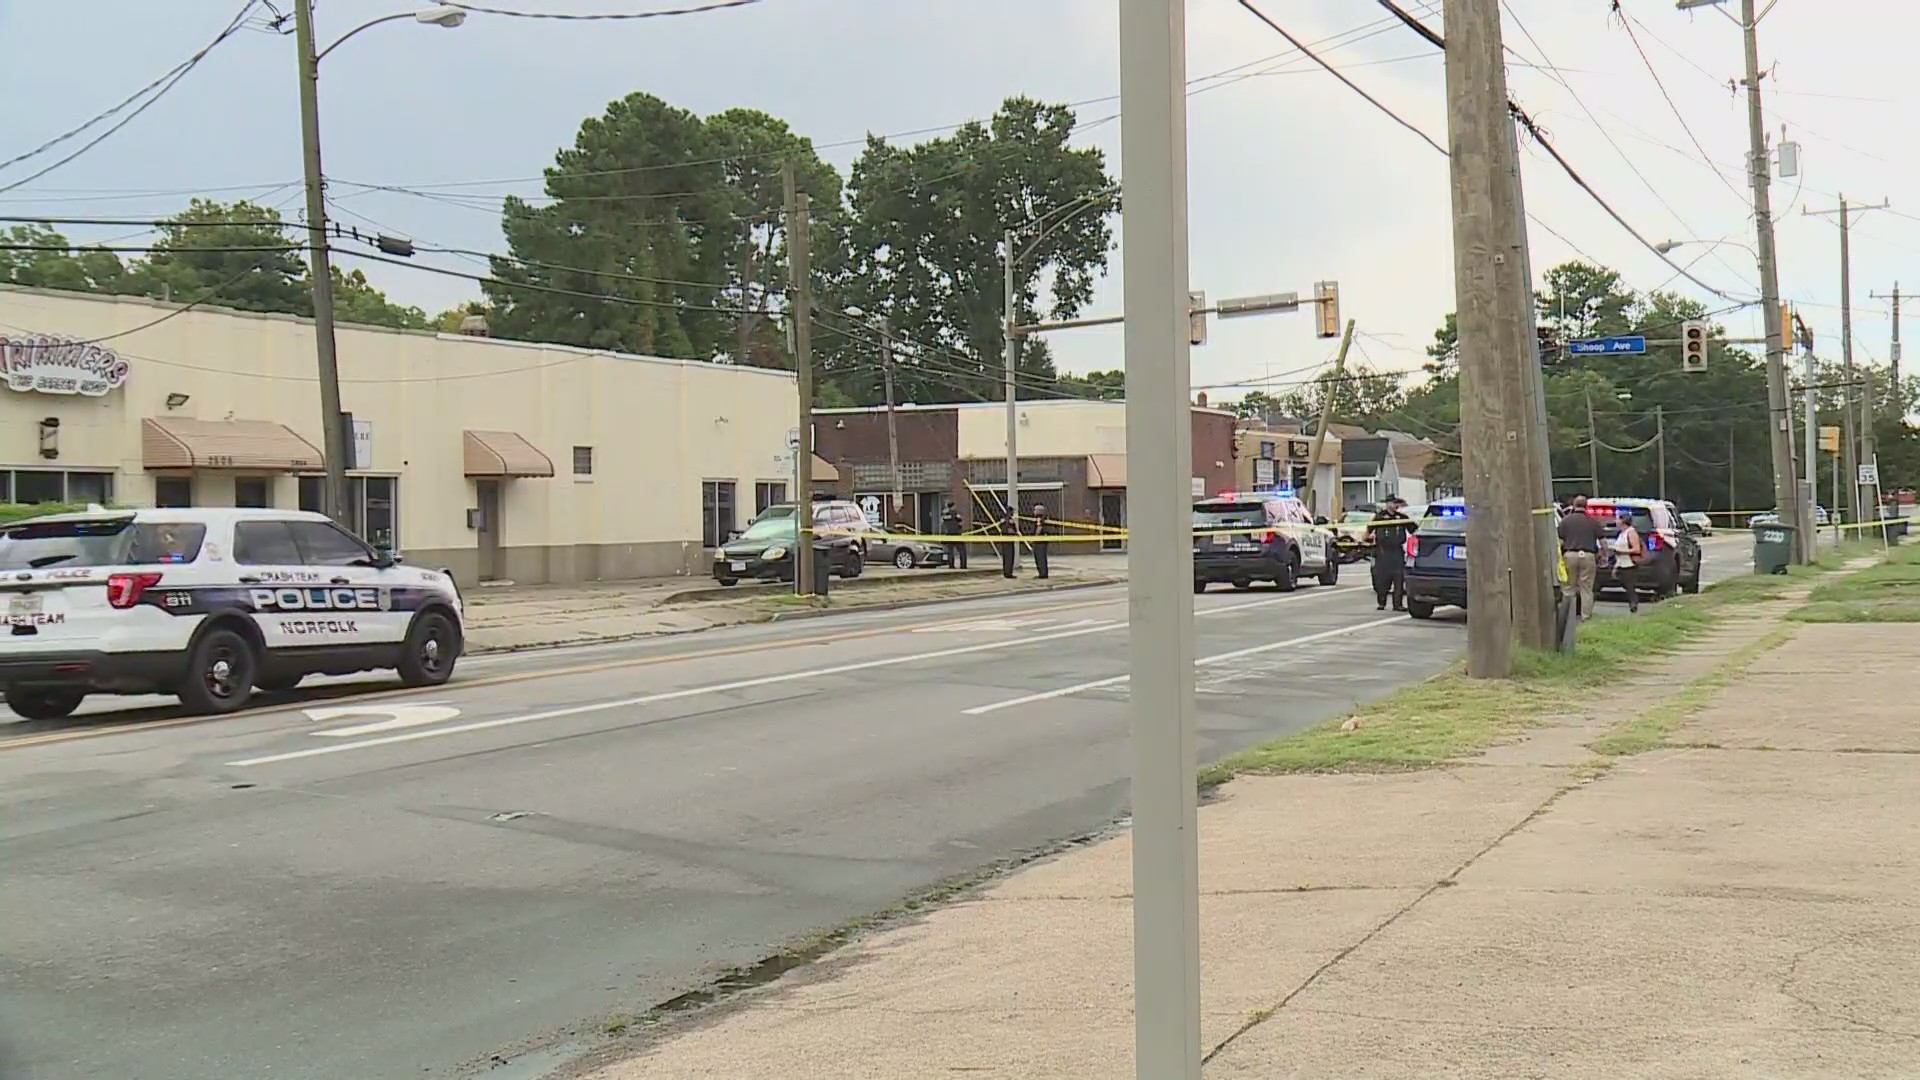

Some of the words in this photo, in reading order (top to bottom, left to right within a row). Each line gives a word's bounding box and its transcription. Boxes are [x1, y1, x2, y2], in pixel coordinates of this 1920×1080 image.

[1613, 341, 1631, 350] Ave
[1861, 474, 1875, 482] 35
[261, 571, 293, 582] CRASH
[294, 572, 320, 582] TEAM
[249, 588, 378, 609] POLICE
[31, 613, 65, 624] TEAM
[280, 620, 357, 634] NORFOLK
